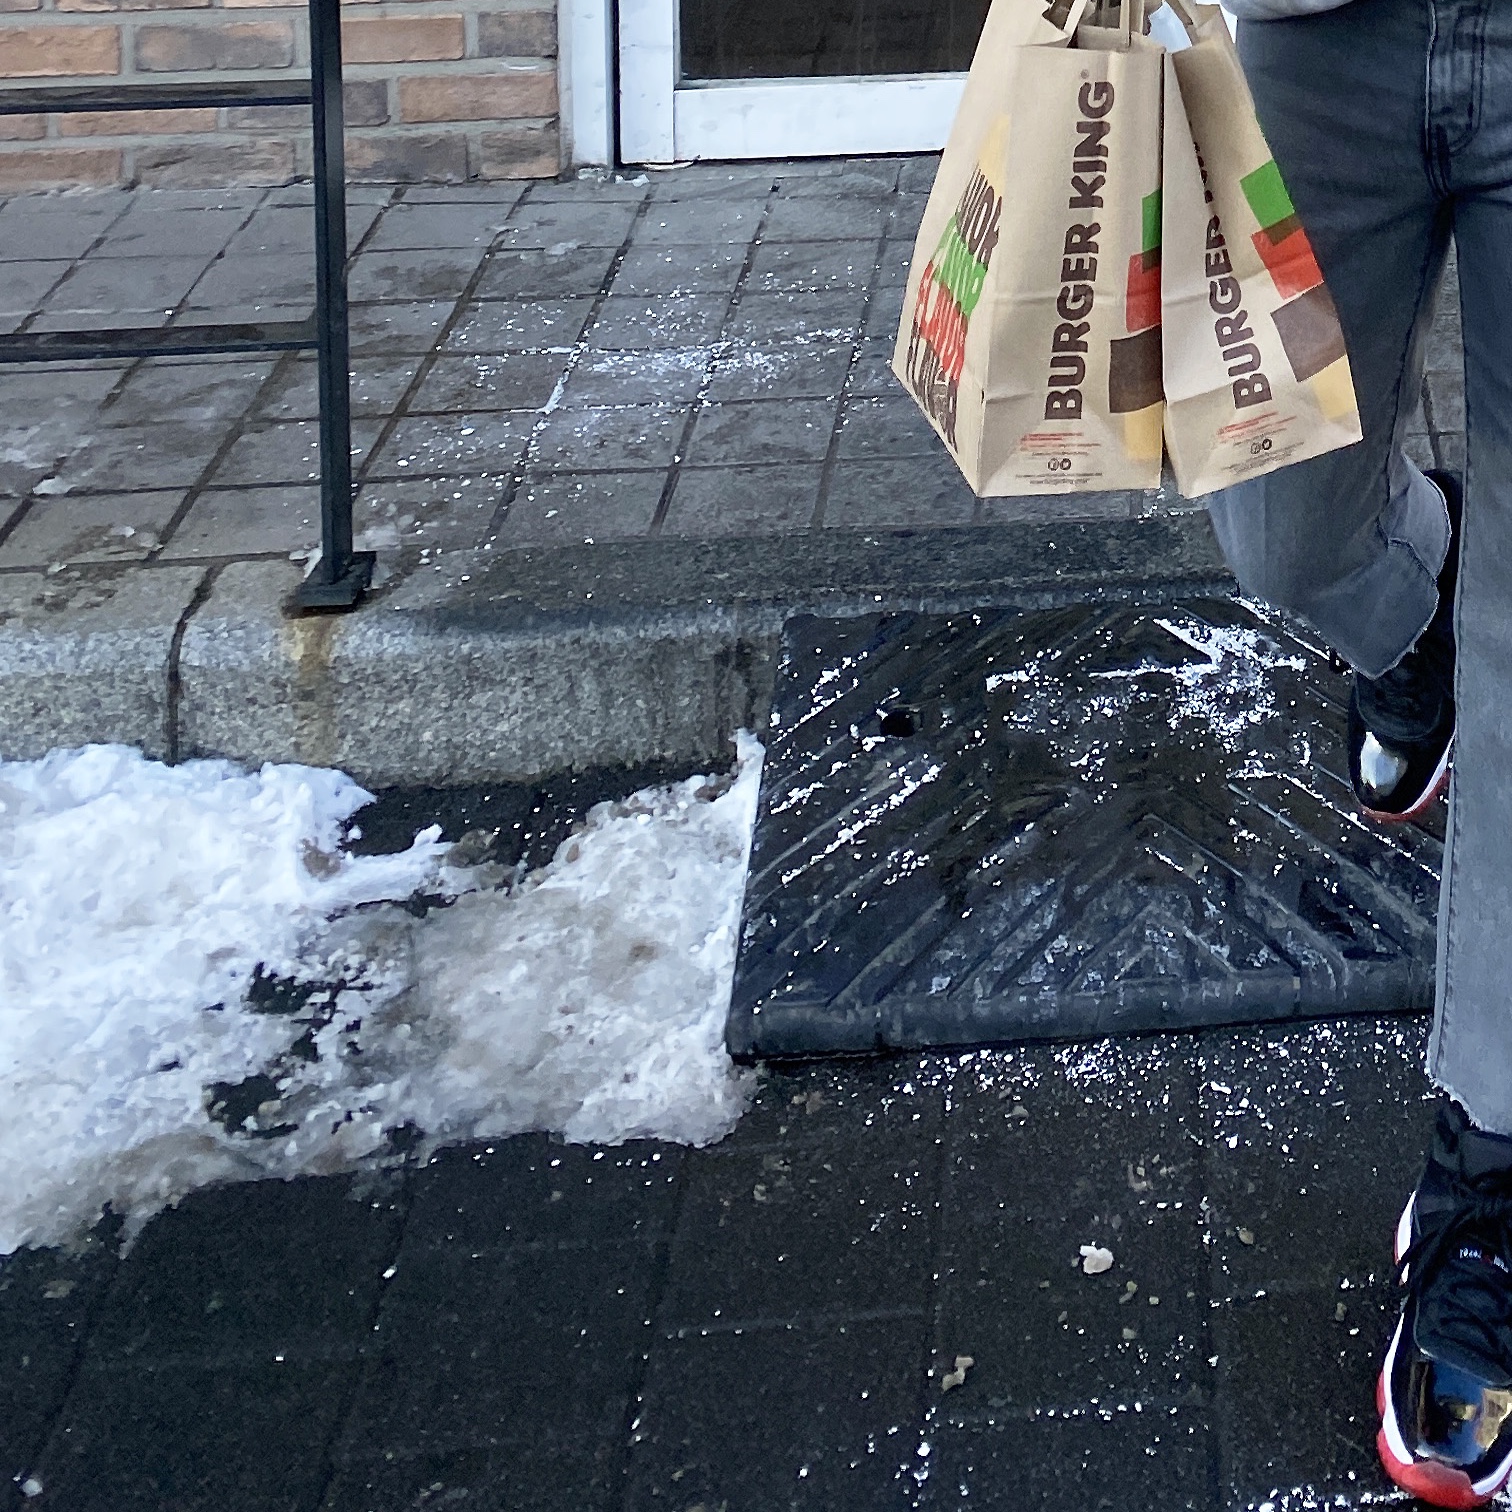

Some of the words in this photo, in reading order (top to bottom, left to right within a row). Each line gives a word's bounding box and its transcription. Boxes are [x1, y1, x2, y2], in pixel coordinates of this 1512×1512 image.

[1068, 78, 1116, 210] KING
[1044, 223, 1102, 420] BURGER
[1204, 213, 1273, 411] BURGER
